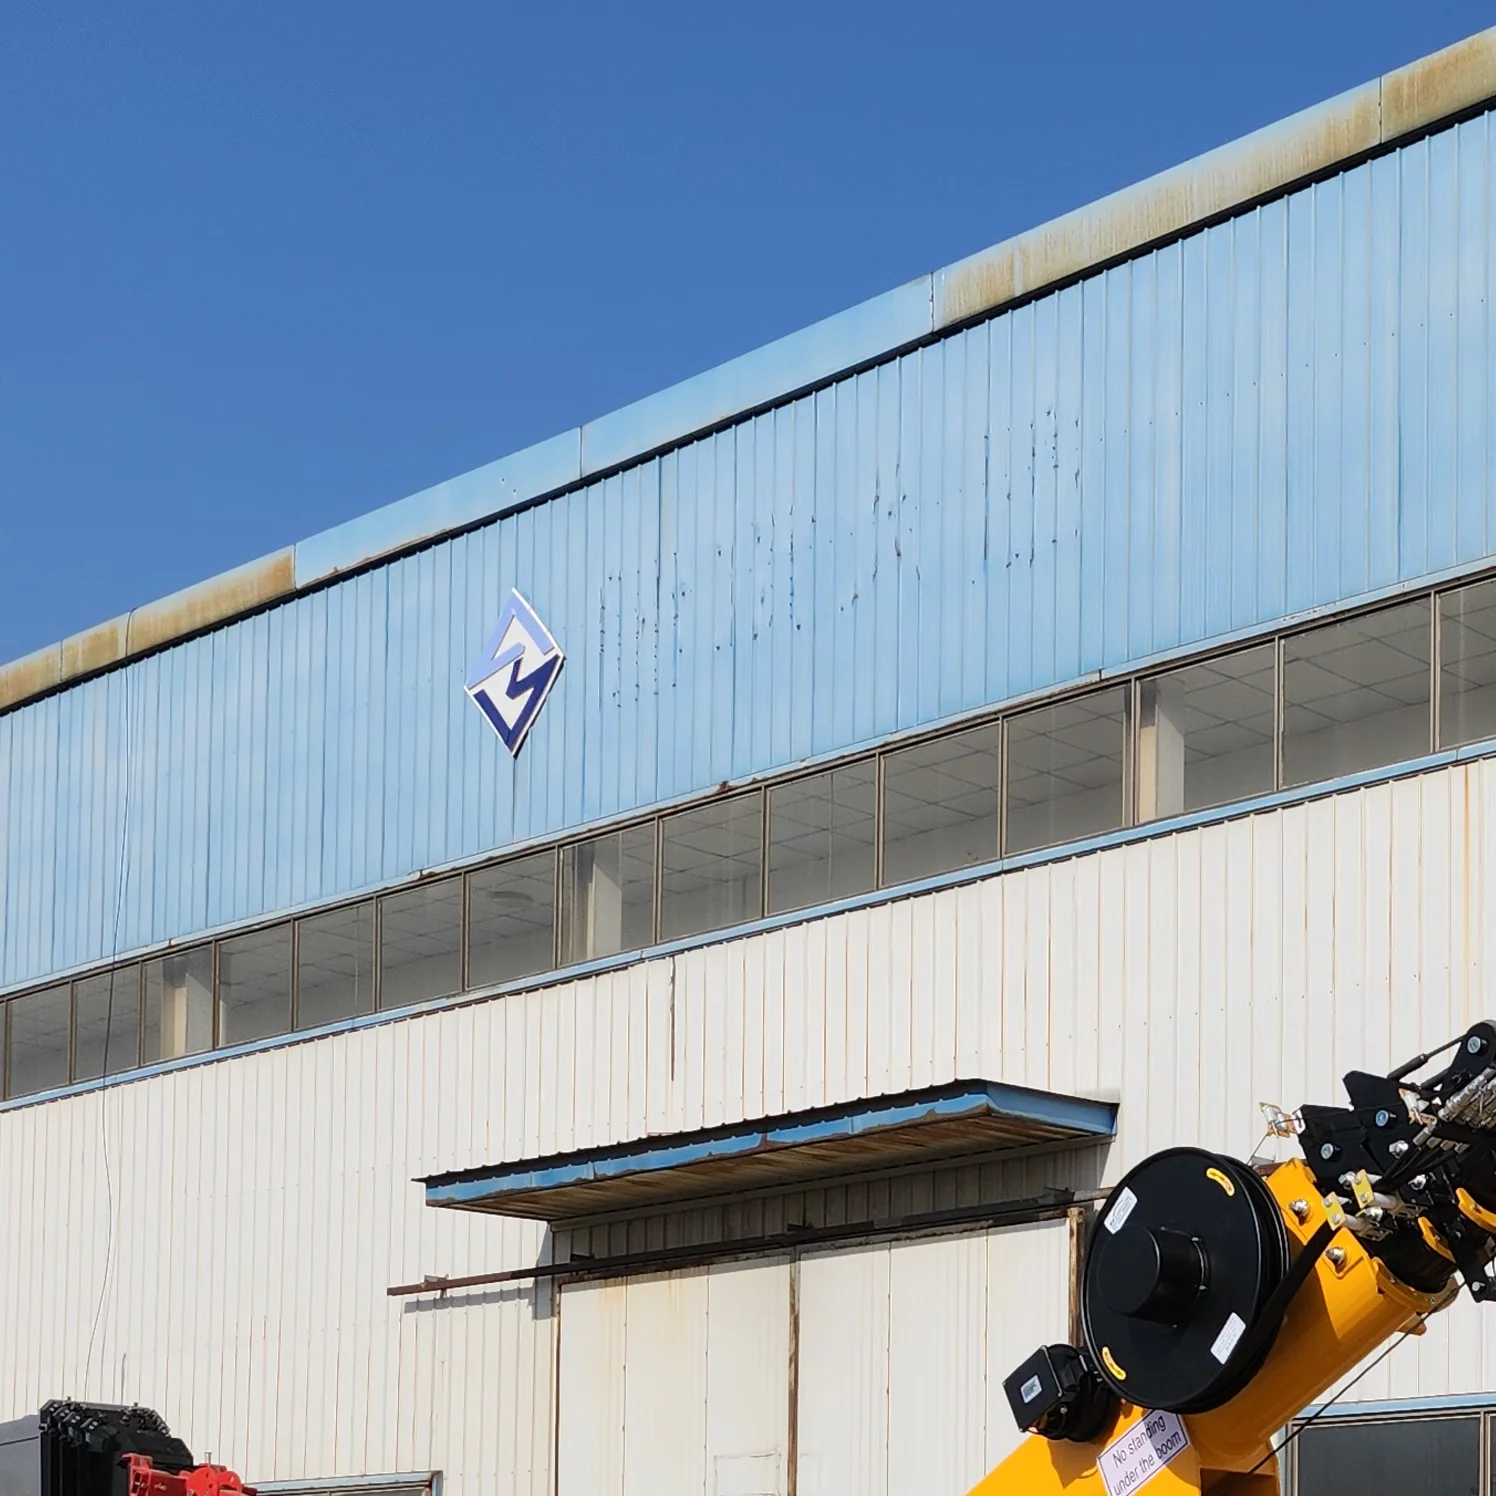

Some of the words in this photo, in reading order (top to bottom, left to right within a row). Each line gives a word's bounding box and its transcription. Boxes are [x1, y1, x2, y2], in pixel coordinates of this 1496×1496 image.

[1113, 1449, 1127, 1468] No
[1128, 1415, 1167, 1455] standing
[1114, 1467, 1140, 1496] under
[1139, 1454, 1155, 1474] the
[1154, 1431, 1181, 1459] boom
